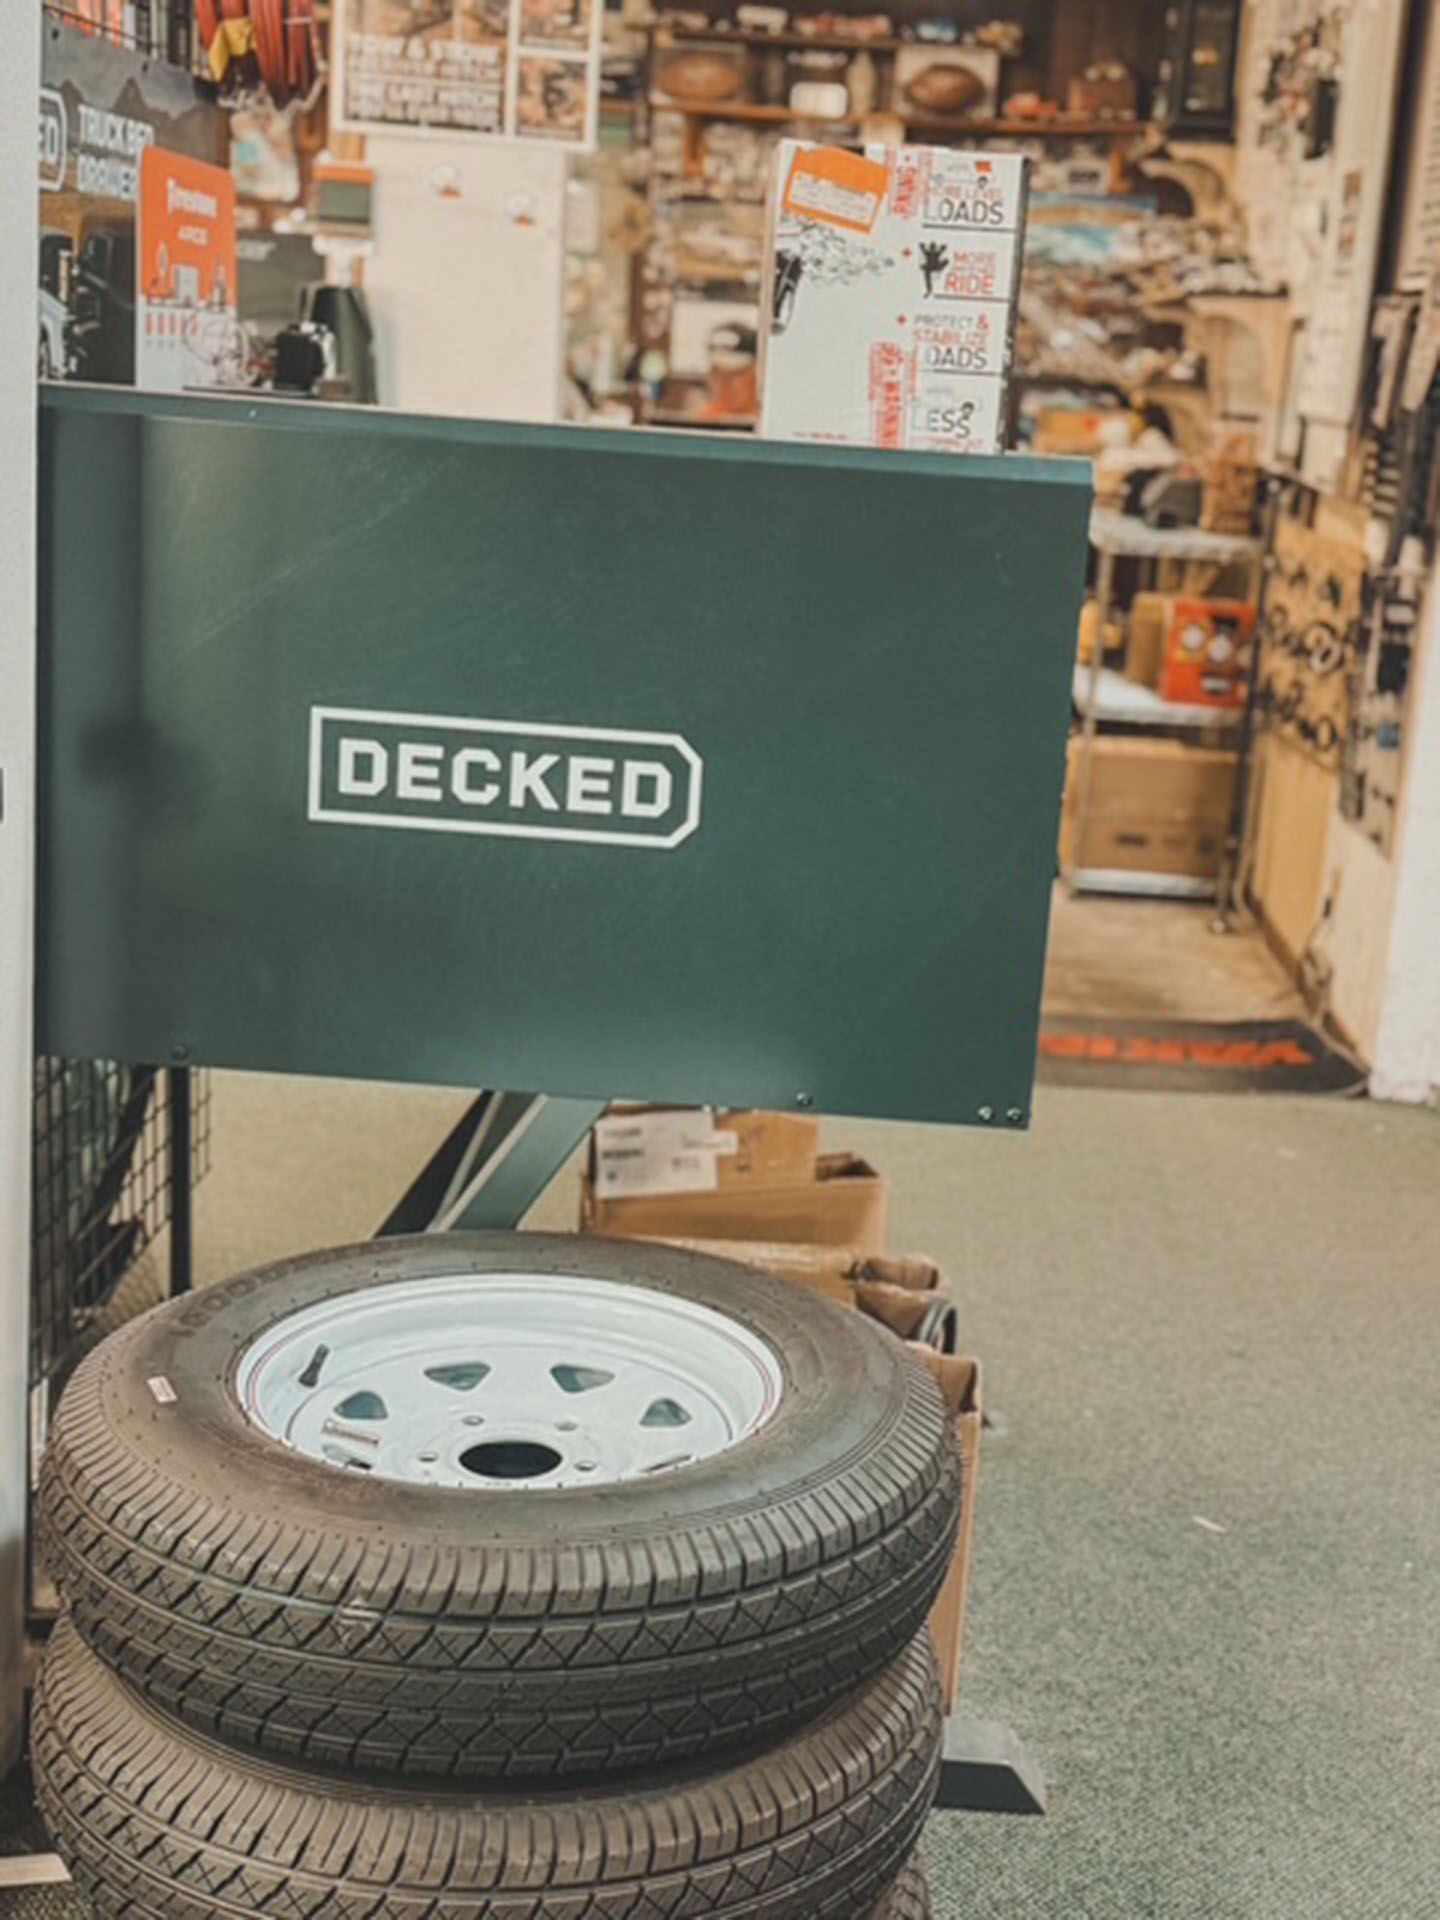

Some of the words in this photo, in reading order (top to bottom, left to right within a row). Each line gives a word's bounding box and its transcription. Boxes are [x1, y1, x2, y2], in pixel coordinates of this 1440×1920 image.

[78, 103, 126, 152] TRUCK
[922, 198, 1005, 226] LOADS
[945, 271, 996, 294] RIDE
[913, 314, 973, 331] PROTECT
[978, 313, 990, 331] &
[338, 737, 673, 819] DECKED
